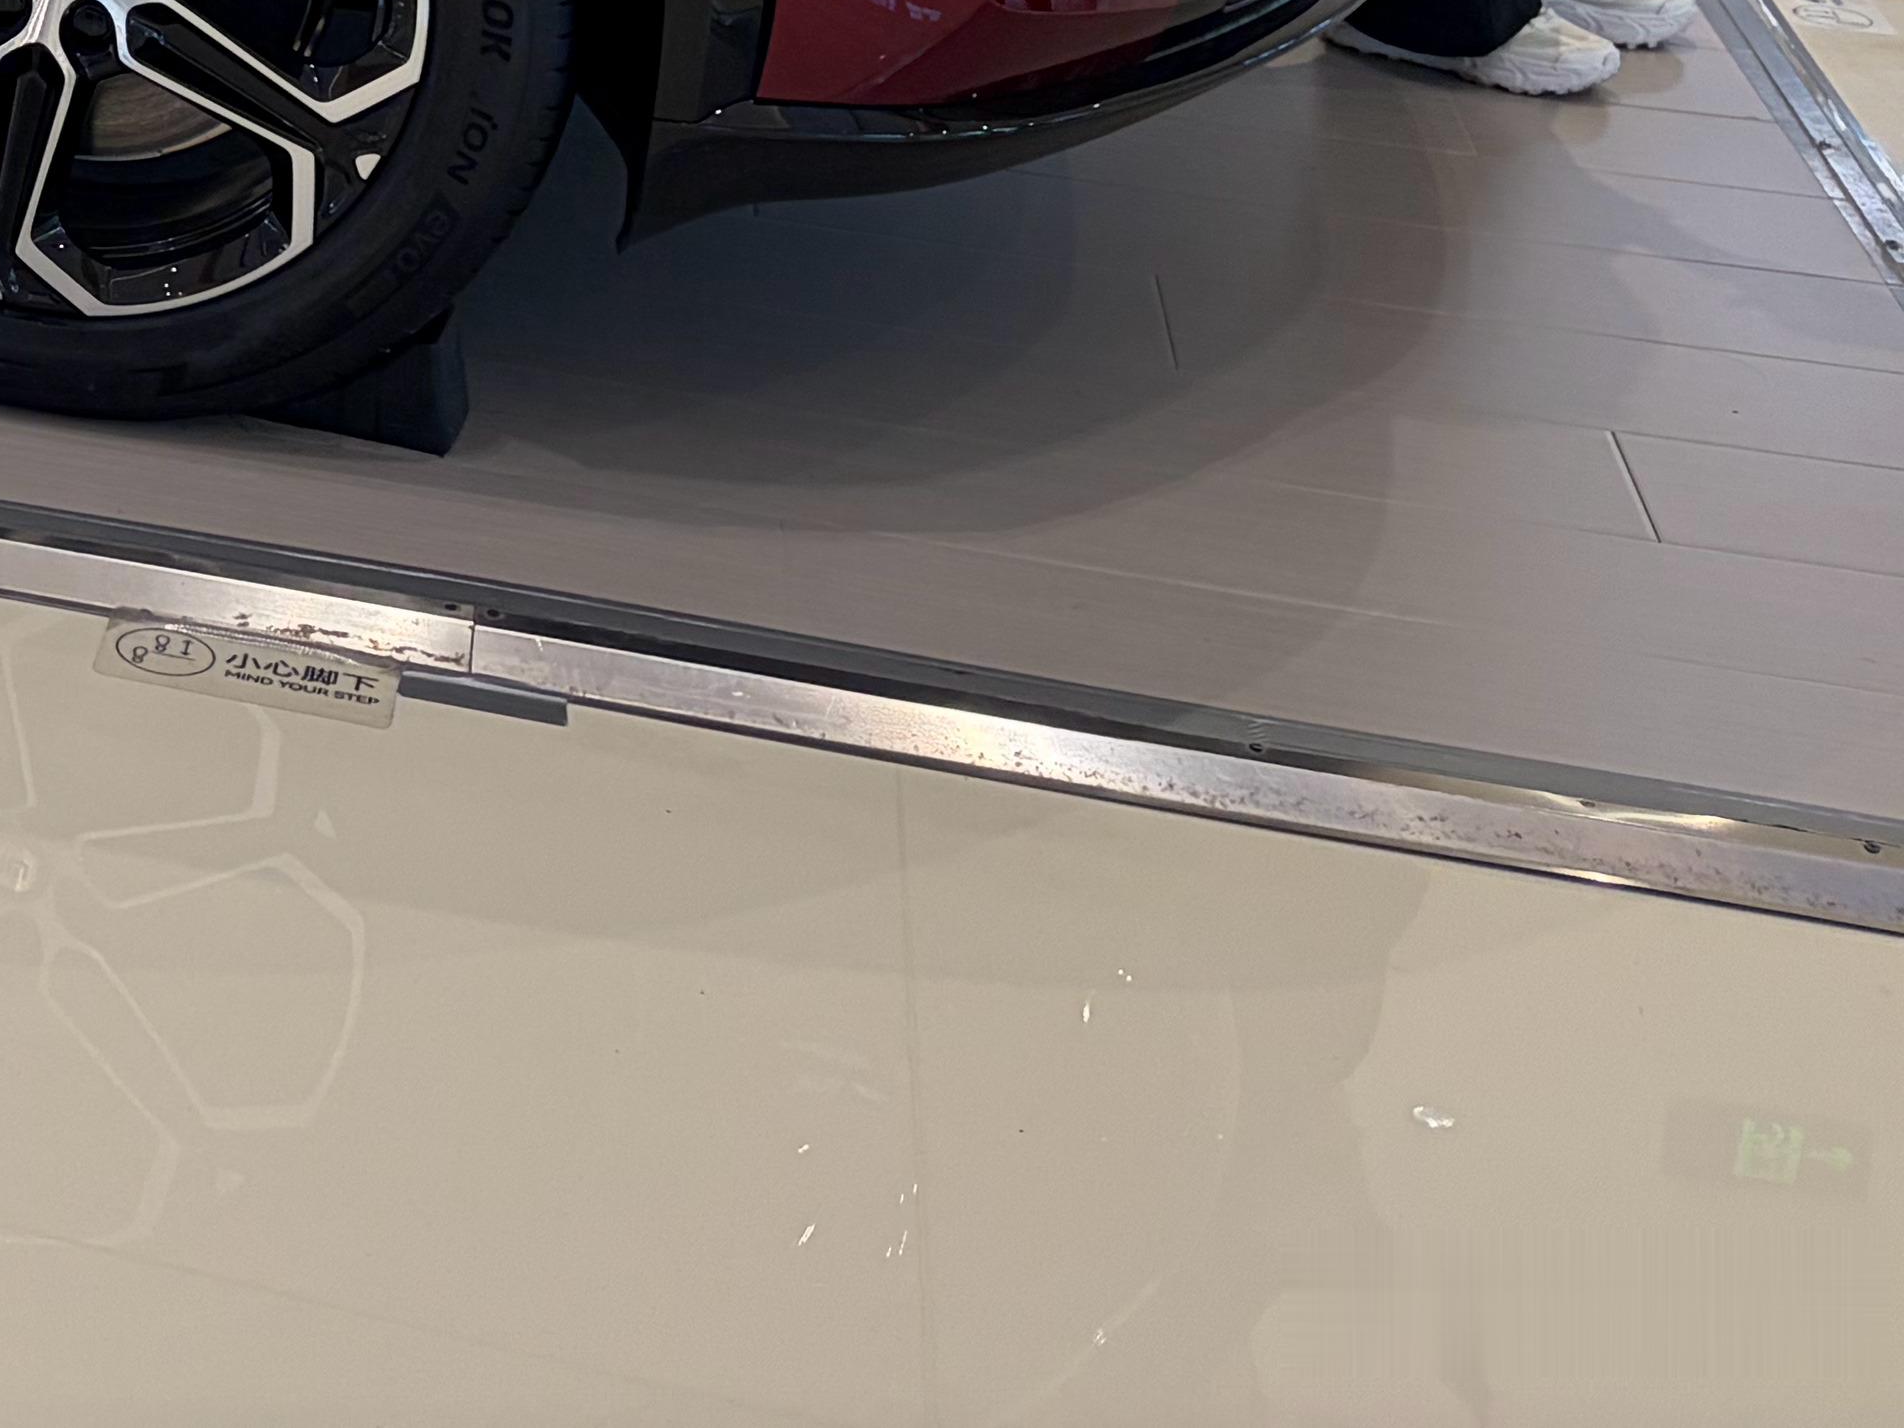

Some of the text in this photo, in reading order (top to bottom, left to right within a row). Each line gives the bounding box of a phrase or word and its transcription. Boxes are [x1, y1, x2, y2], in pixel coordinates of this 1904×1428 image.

[225, 670, 380, 705] MIND YOUR STEP
[226, 653, 379, 690] 小心脚下
